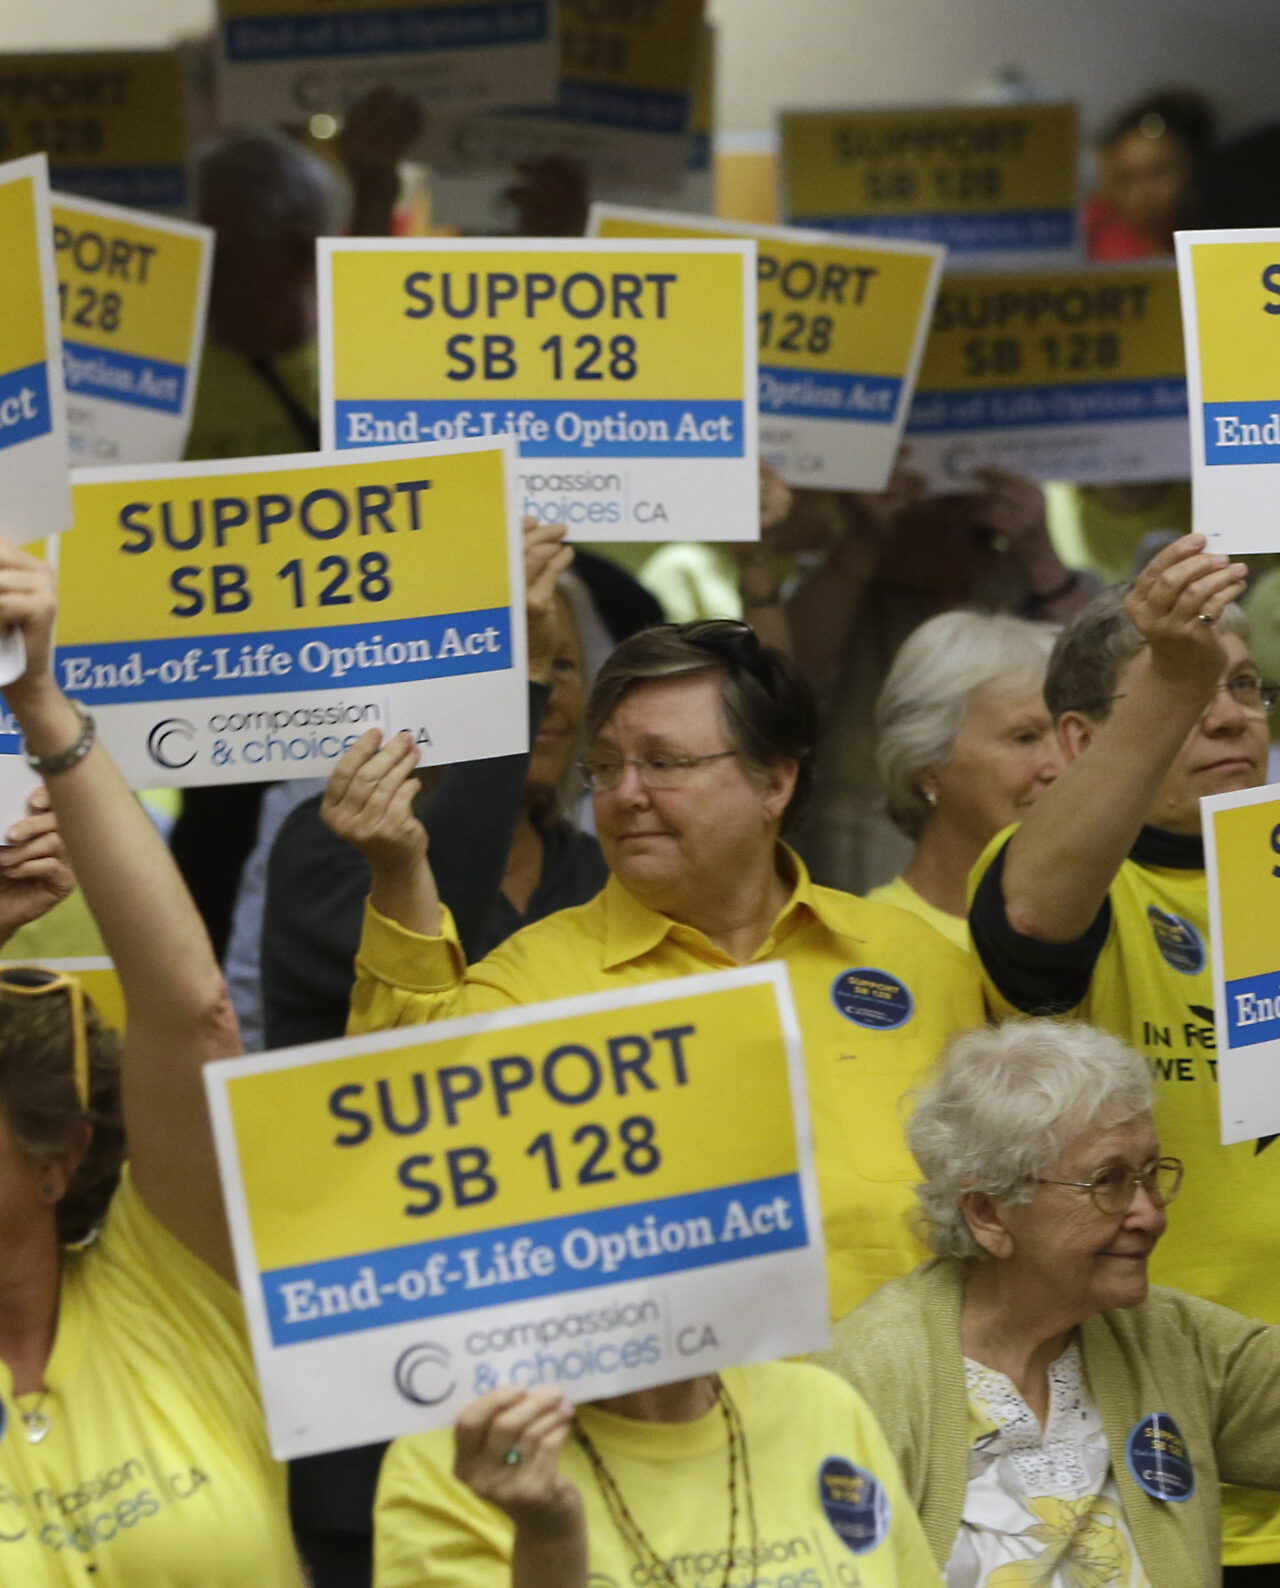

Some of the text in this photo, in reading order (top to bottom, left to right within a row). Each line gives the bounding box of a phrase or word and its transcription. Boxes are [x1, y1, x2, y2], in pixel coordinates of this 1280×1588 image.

[53, 225, 156, 286] PORT
[404, 272, 677, 319] SUPPORT
[758, 256, 878, 306] PORT
[57, 282, 123, 333] 128
[759, 310, 834, 354] 128
[446, 334, 638, 381] SB 128
[0, 387, 38, 427] ct
[135, 366, 180, 401] Act
[847, 382, 893, 412] Act
[347, 411, 732, 447] End-of-Life Option Act
[520, 468, 620, 493] passion
[119, 479, 432, 555] SUPPORT
[524, 495, 669, 524] hoices CA
[169, 552, 392, 618] SB 128
[62, 626, 501, 692] End-of-Life Option Act
[208, 700, 380, 734] compassion
[211, 739, 233, 767] &
[242, 733, 364, 765] choice
[1143, 1021, 1172, 1048] IN
[328, 1023, 697, 1148] SUPPORT
[396, 1114, 662, 1218] SB 128
[278, 1196, 795, 1325] End-of-Life Option Act
[465, 1296, 660, 1358] compassion
[472, 1324, 720, 1398] & choices CA
